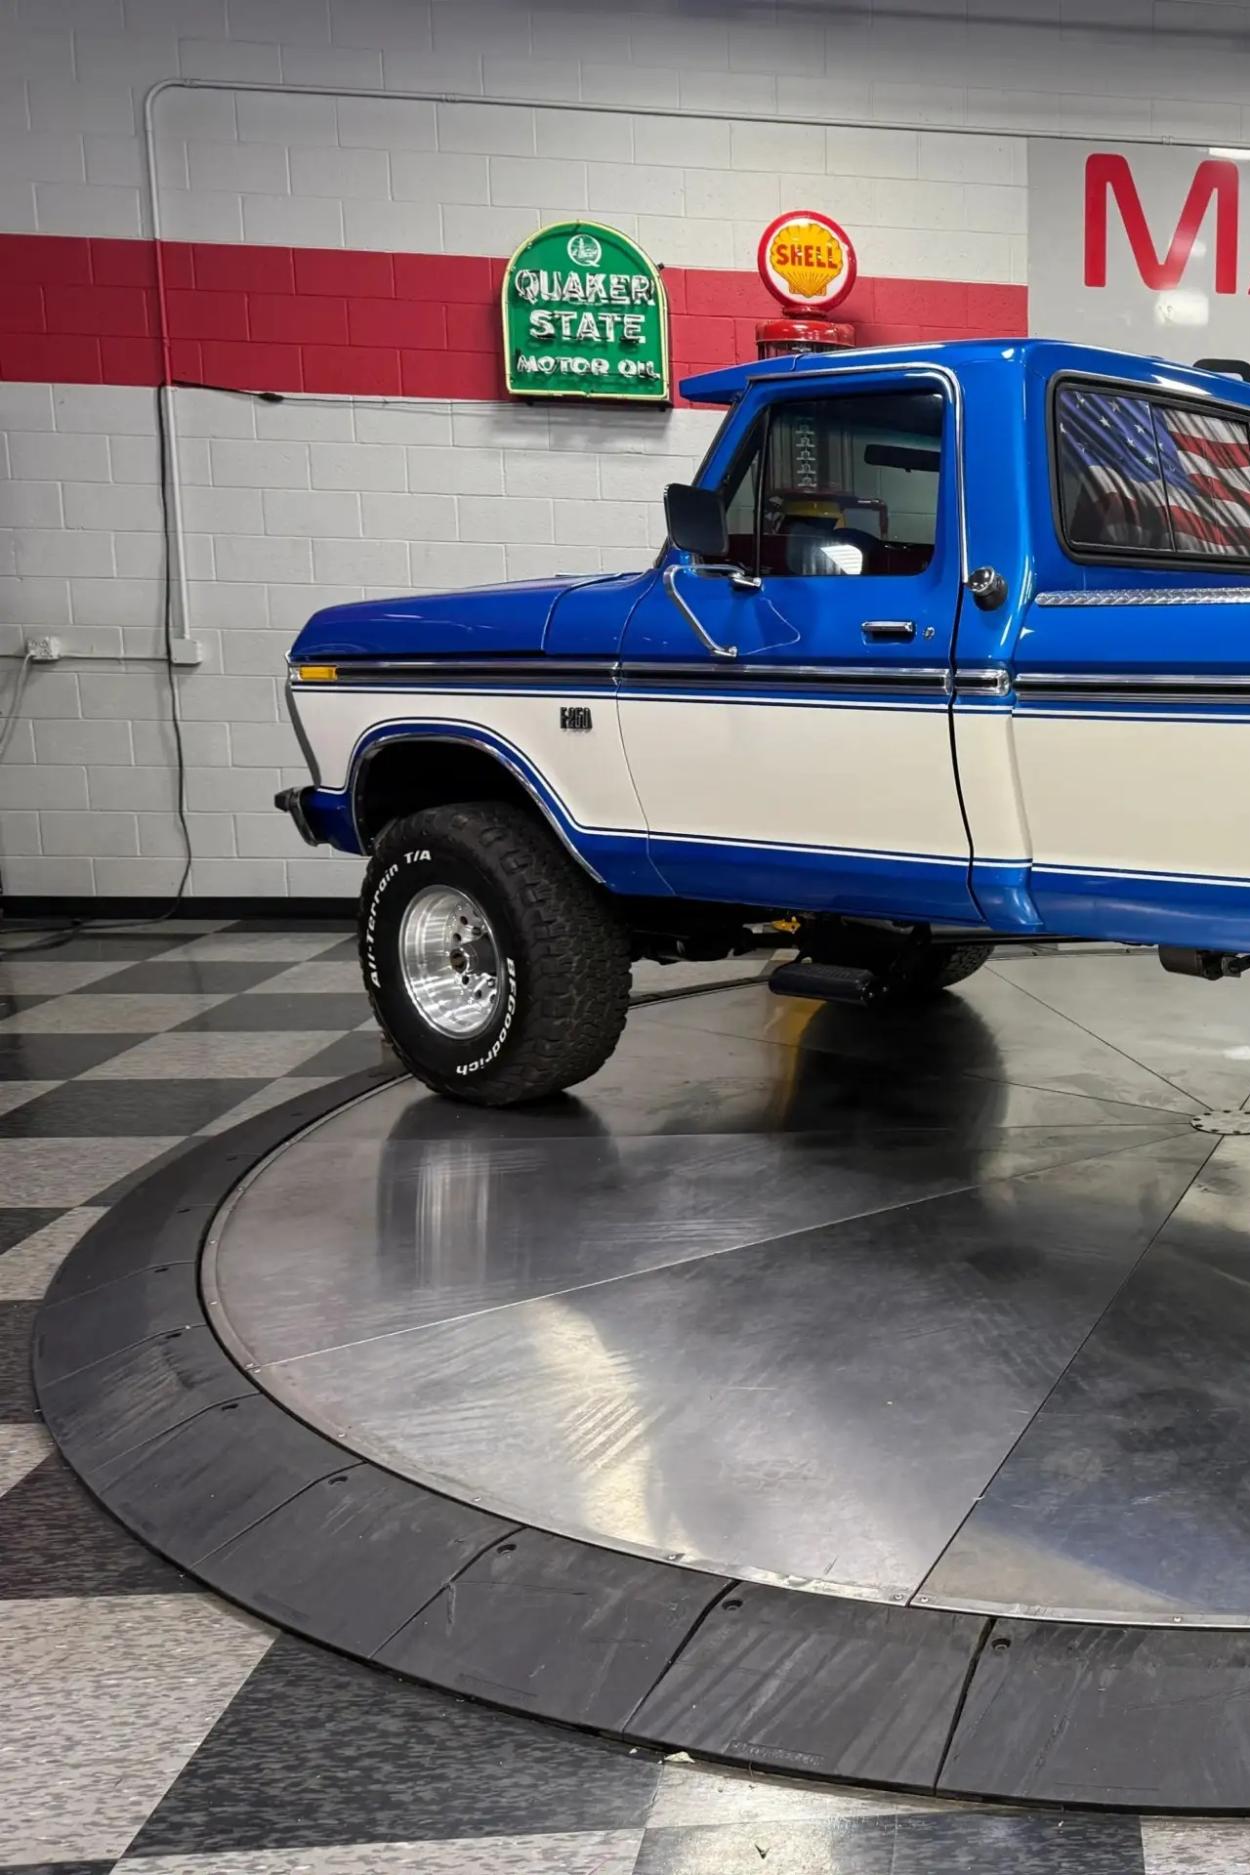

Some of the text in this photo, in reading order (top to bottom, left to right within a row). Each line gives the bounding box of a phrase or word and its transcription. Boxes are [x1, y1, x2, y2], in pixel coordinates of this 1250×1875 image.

[775, 243, 839, 269] SHELL
[515, 269, 656, 306] QUAKER
[529, 309, 647, 344] STATE
[517, 354, 661, 380] MOTOR OIL
[365, 849, 432, 989] All-Terrain T/A
[456, 957, 518, 1076] BFGoodrich
